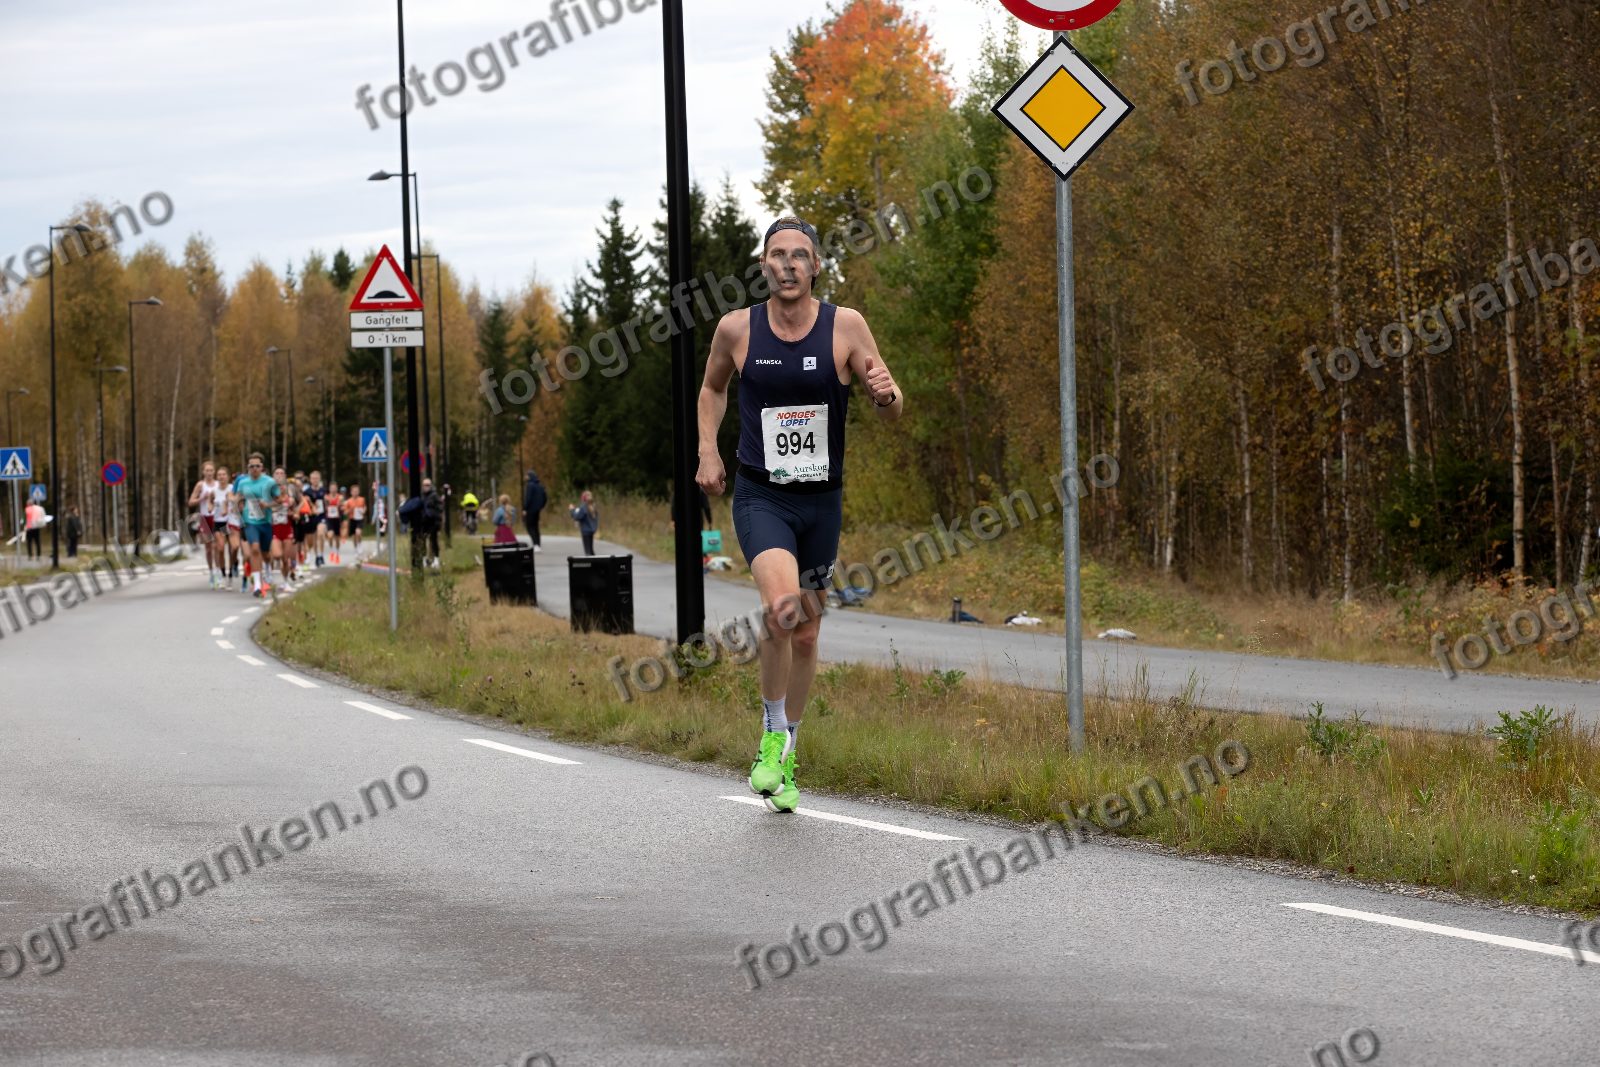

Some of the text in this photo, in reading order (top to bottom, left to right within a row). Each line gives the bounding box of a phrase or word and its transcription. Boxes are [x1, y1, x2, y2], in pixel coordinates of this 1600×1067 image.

[365, 315, 409, 327] Gangfelt
[368, 335, 375, 344] 0
[392, 335, 407, 344] km
[776, 410, 816, 420] NORGES
[780, 418, 810, 427] LØPET
[776, 431, 816, 457] 994
[794, 464, 827, 474] Aurskog
